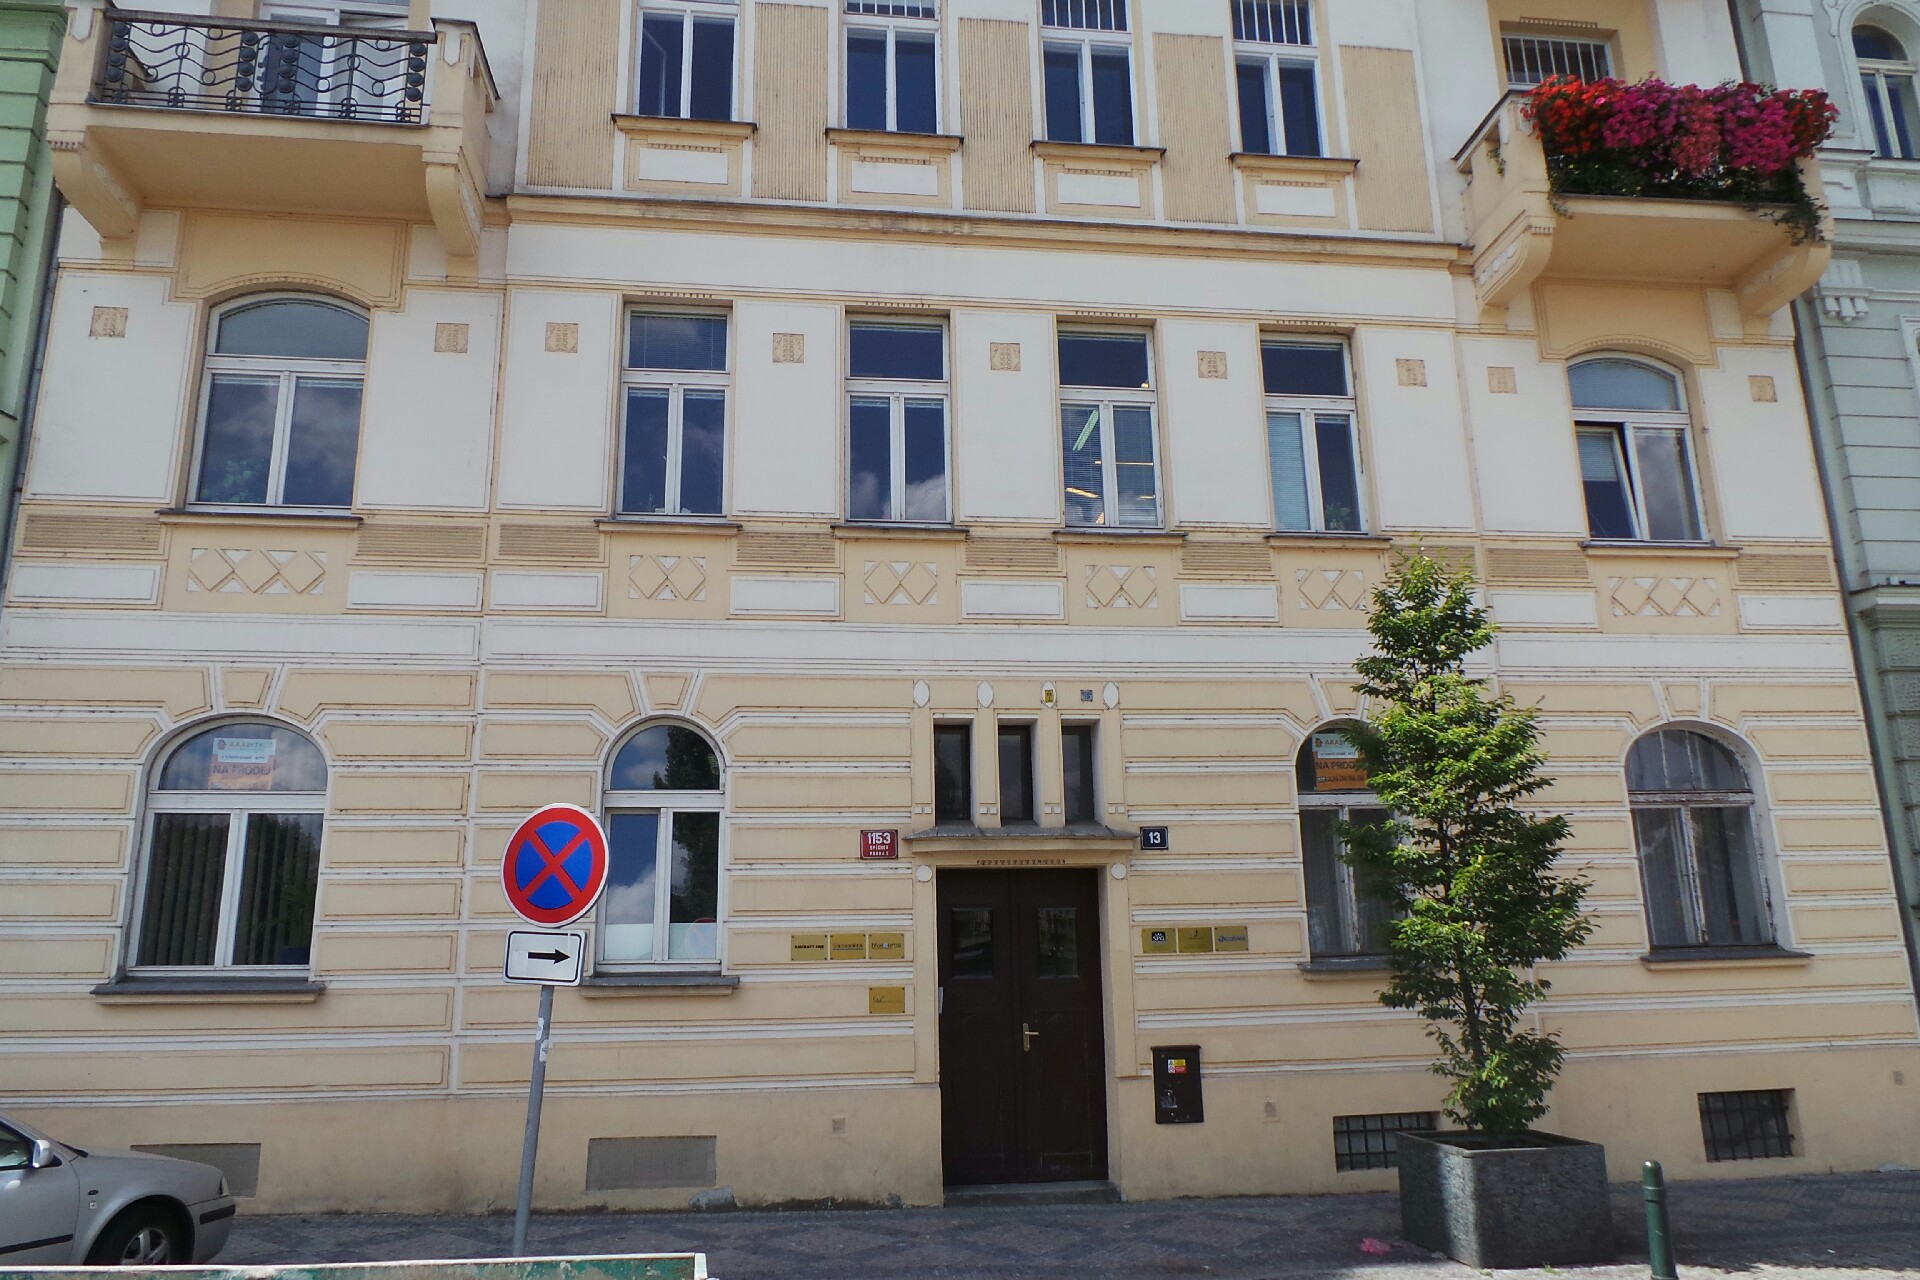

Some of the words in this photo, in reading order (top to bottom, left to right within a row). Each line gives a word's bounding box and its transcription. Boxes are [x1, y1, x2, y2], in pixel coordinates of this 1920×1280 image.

[213, 765, 228, 774] NA
[232, 765, 271, 775] PRODEJ
[1316, 761, 1330, 769] NA
[867, 832, 891, 845] 1153
[1148, 831, 1161, 844] 13
